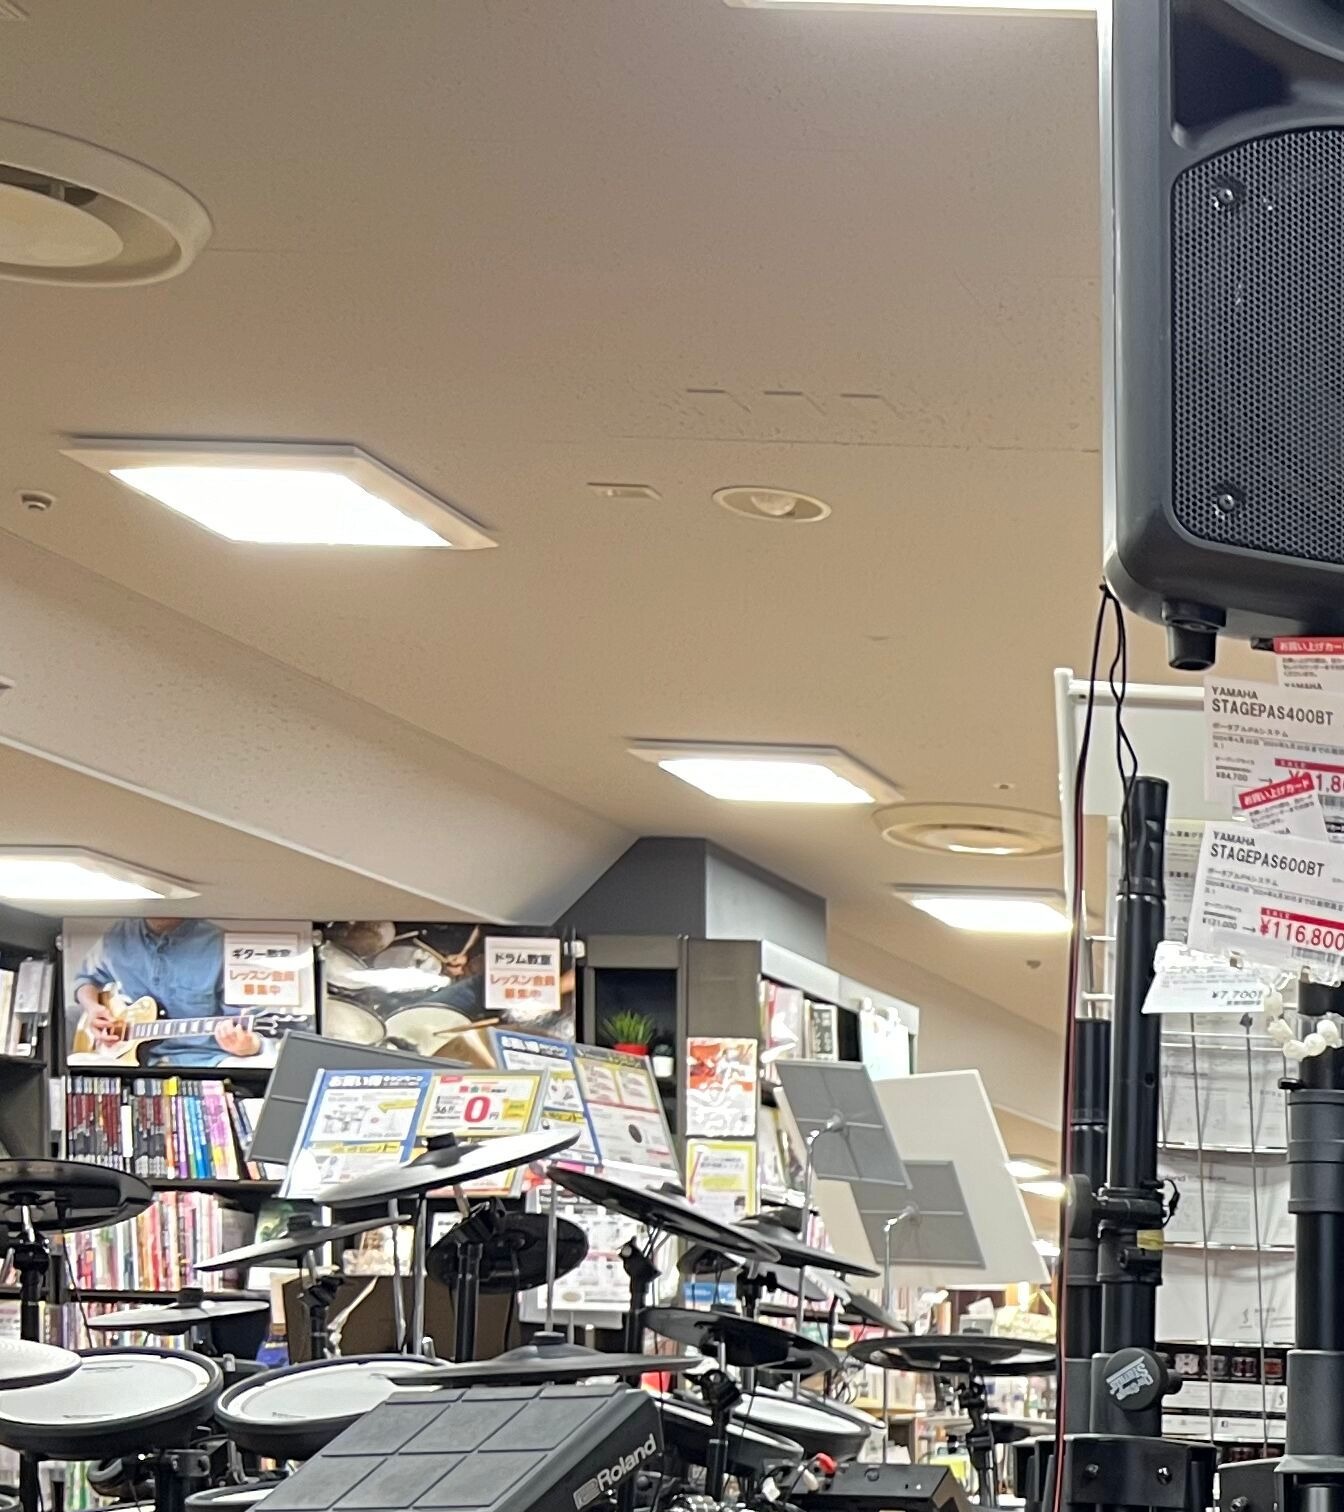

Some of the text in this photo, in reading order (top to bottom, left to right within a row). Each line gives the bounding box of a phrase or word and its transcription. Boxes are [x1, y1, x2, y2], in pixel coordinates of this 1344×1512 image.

[1212, 685, 1259, 700] YAMAHA
[1212, 697, 1335, 726] STAGEPAS400BT
[1212, 830, 1256, 848] YAMAHA
[1211, 843, 1325, 879] STAGEPAS600BT
[597, 1432, 657, 1492] Roland
